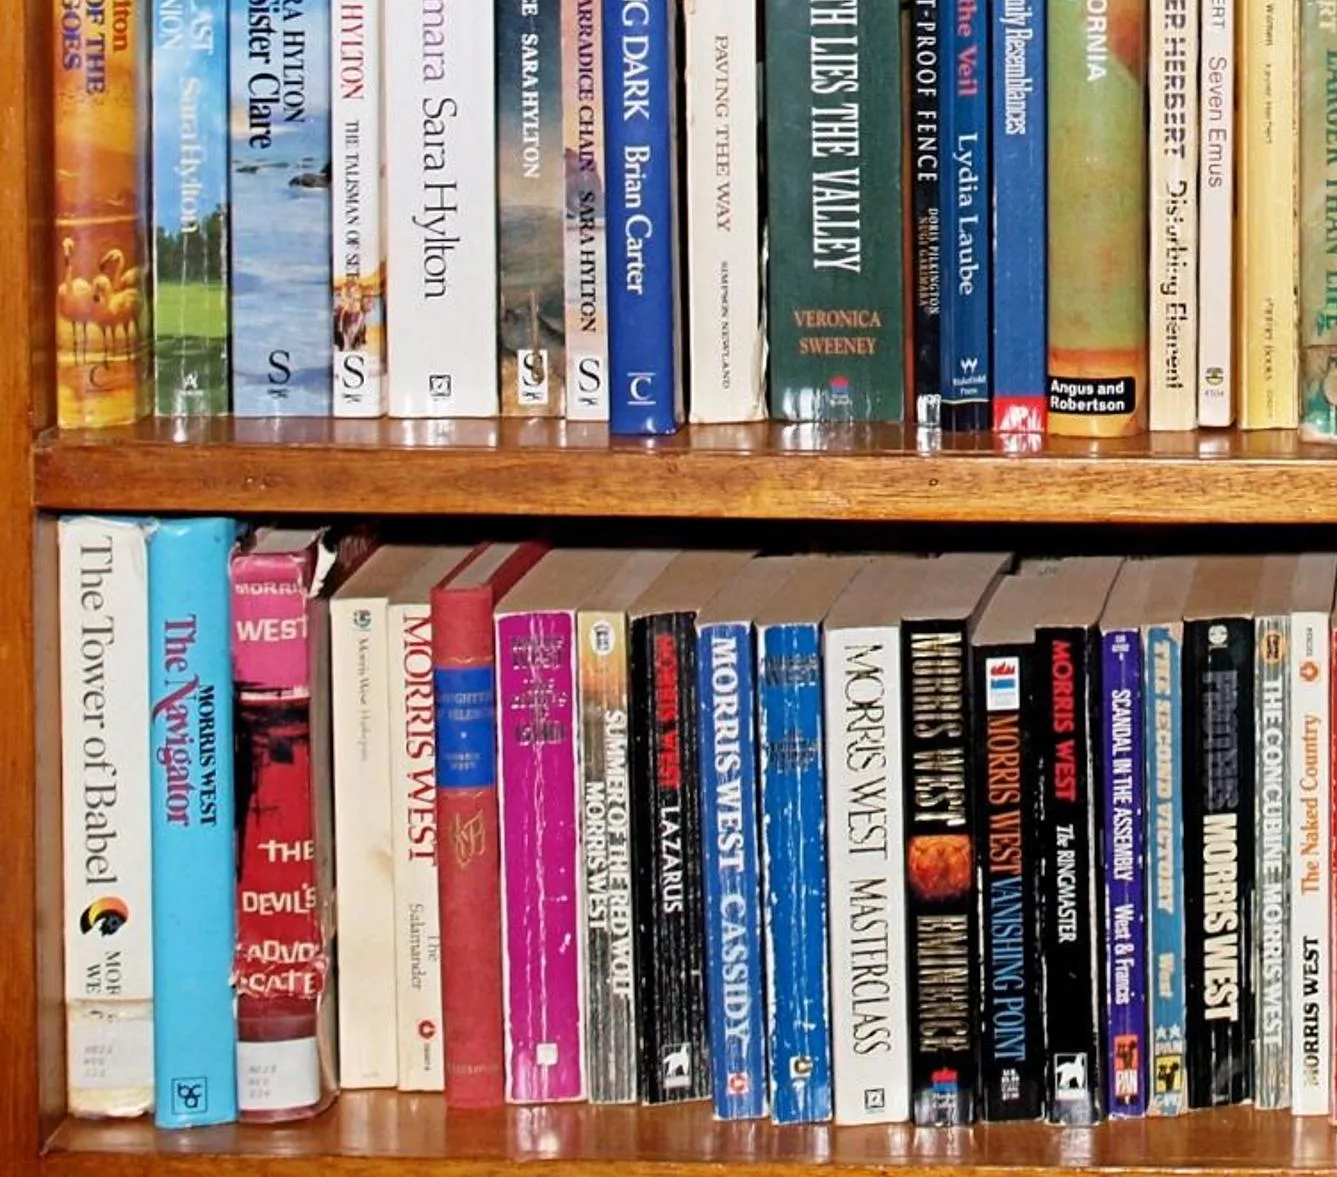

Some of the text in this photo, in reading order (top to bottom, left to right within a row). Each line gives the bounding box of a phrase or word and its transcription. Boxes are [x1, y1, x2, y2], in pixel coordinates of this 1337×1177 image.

[522, 33, 538, 88] SARA
[622, 35, 649, 120] DARK
[1005, 28, 1030, 134] Resemblances
[248, 73, 277, 148] Clare
[421, 98, 457, 171] Sara
[522, 92, 539, 178] HYLTON
[917, 110, 937, 182] FENCE
[1207, 57, 1227, 188] Seven Emus
[623, 145, 648, 208] Brian
[412, 180, 459, 298] Hylton
[625, 214, 649, 294] Carter
[929, 245, 939, 314] PILKINGTON
[793, 310, 883, 328] VERONICA
[798, 337, 876, 355] SWEENEY
[1049, 379, 1123, 396] Angus and
[1050, 396, 1125, 412] Robertson
[80, 538, 118, 884] The Tower of Babel
[660, 807, 683, 912] LAZARUS
[1056, 825, 1075, 942] The RINGMASTER
[408, 903, 425, 990] Salamander
[850, 878, 890, 1055] MASTERCLASS
[992, 877, 1026, 1060] VANISHING POINT
